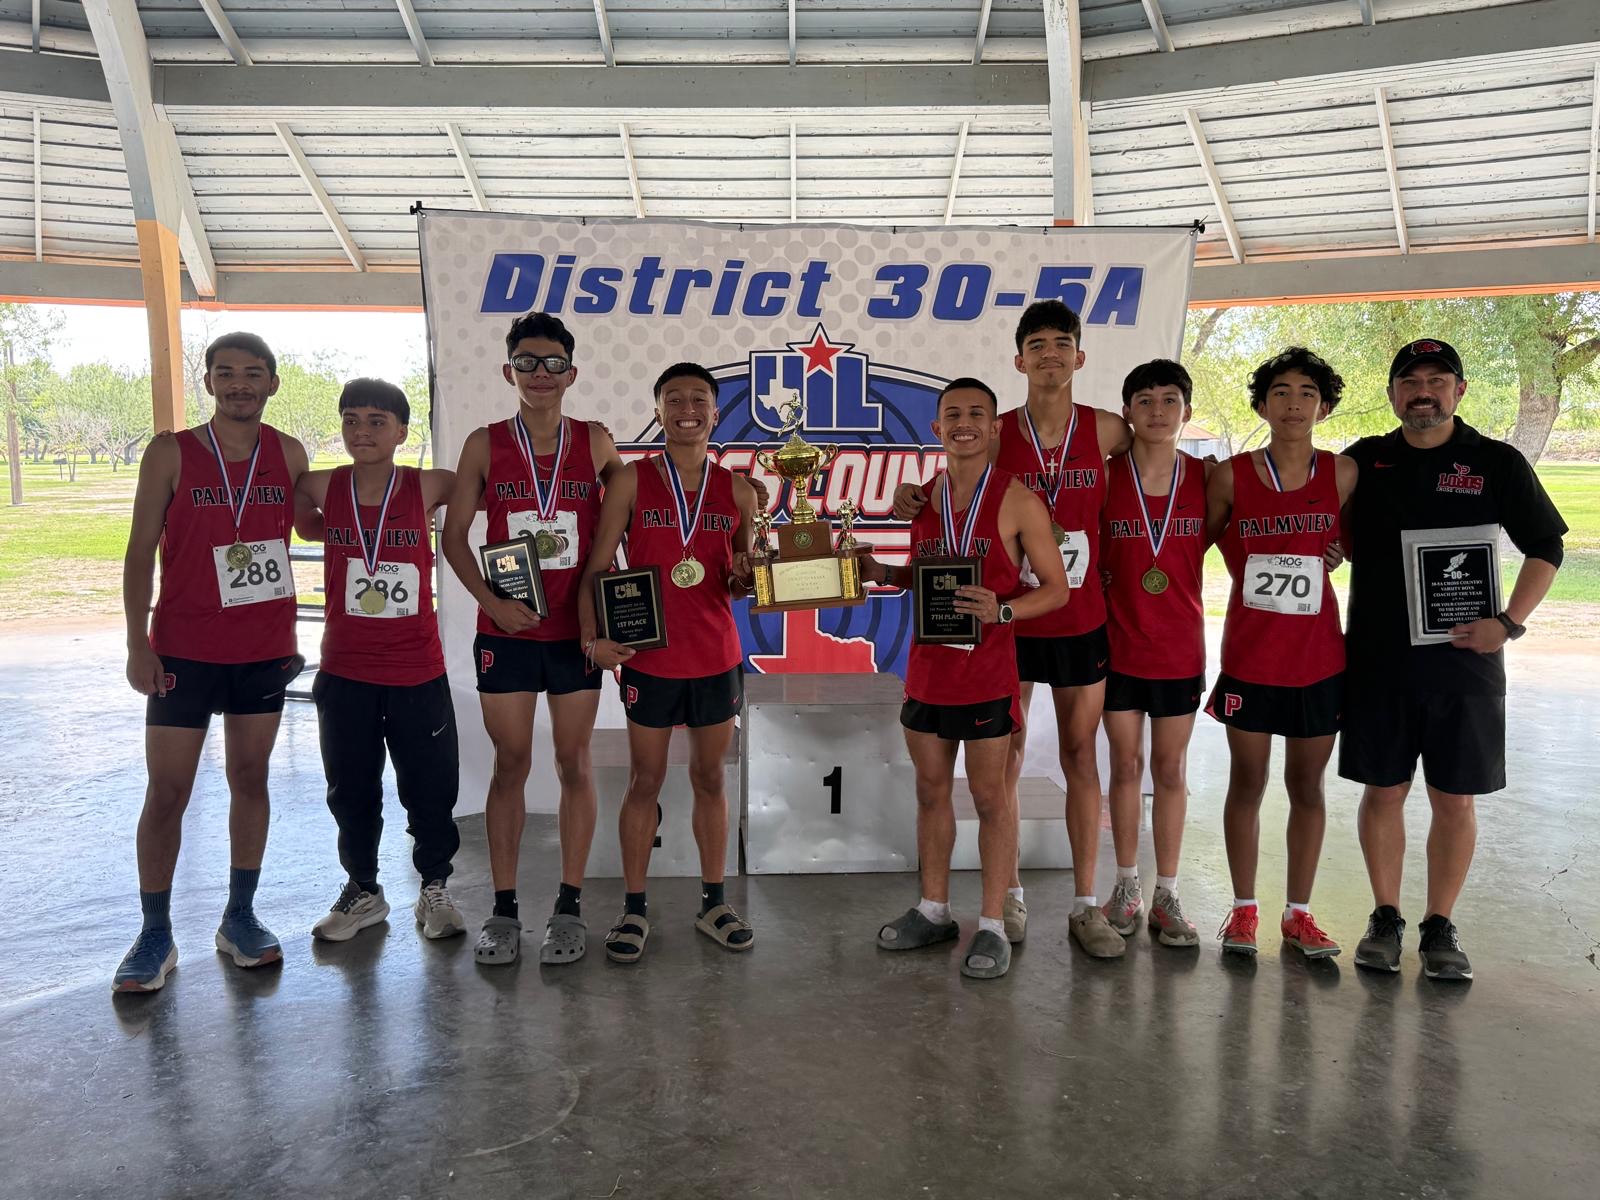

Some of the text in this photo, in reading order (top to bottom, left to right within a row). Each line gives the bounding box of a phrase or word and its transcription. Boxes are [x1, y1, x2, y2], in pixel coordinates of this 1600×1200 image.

[479, 253, 1145, 326] District 30-5A
[227, 559, 282, 589] 288
[377, 563, 400, 573] HOG
[1279, 556, 1303, 567] HOG
[355, 577, 409, 603] 286
[1254, 572, 1311, 598] 270
[627, 618, 647, 627] PLACE
[481, 649, 494, 673] P
[626, 684, 639, 709] P
[1224, 693, 1243, 717] P
[822, 766, 842, 814] 1
